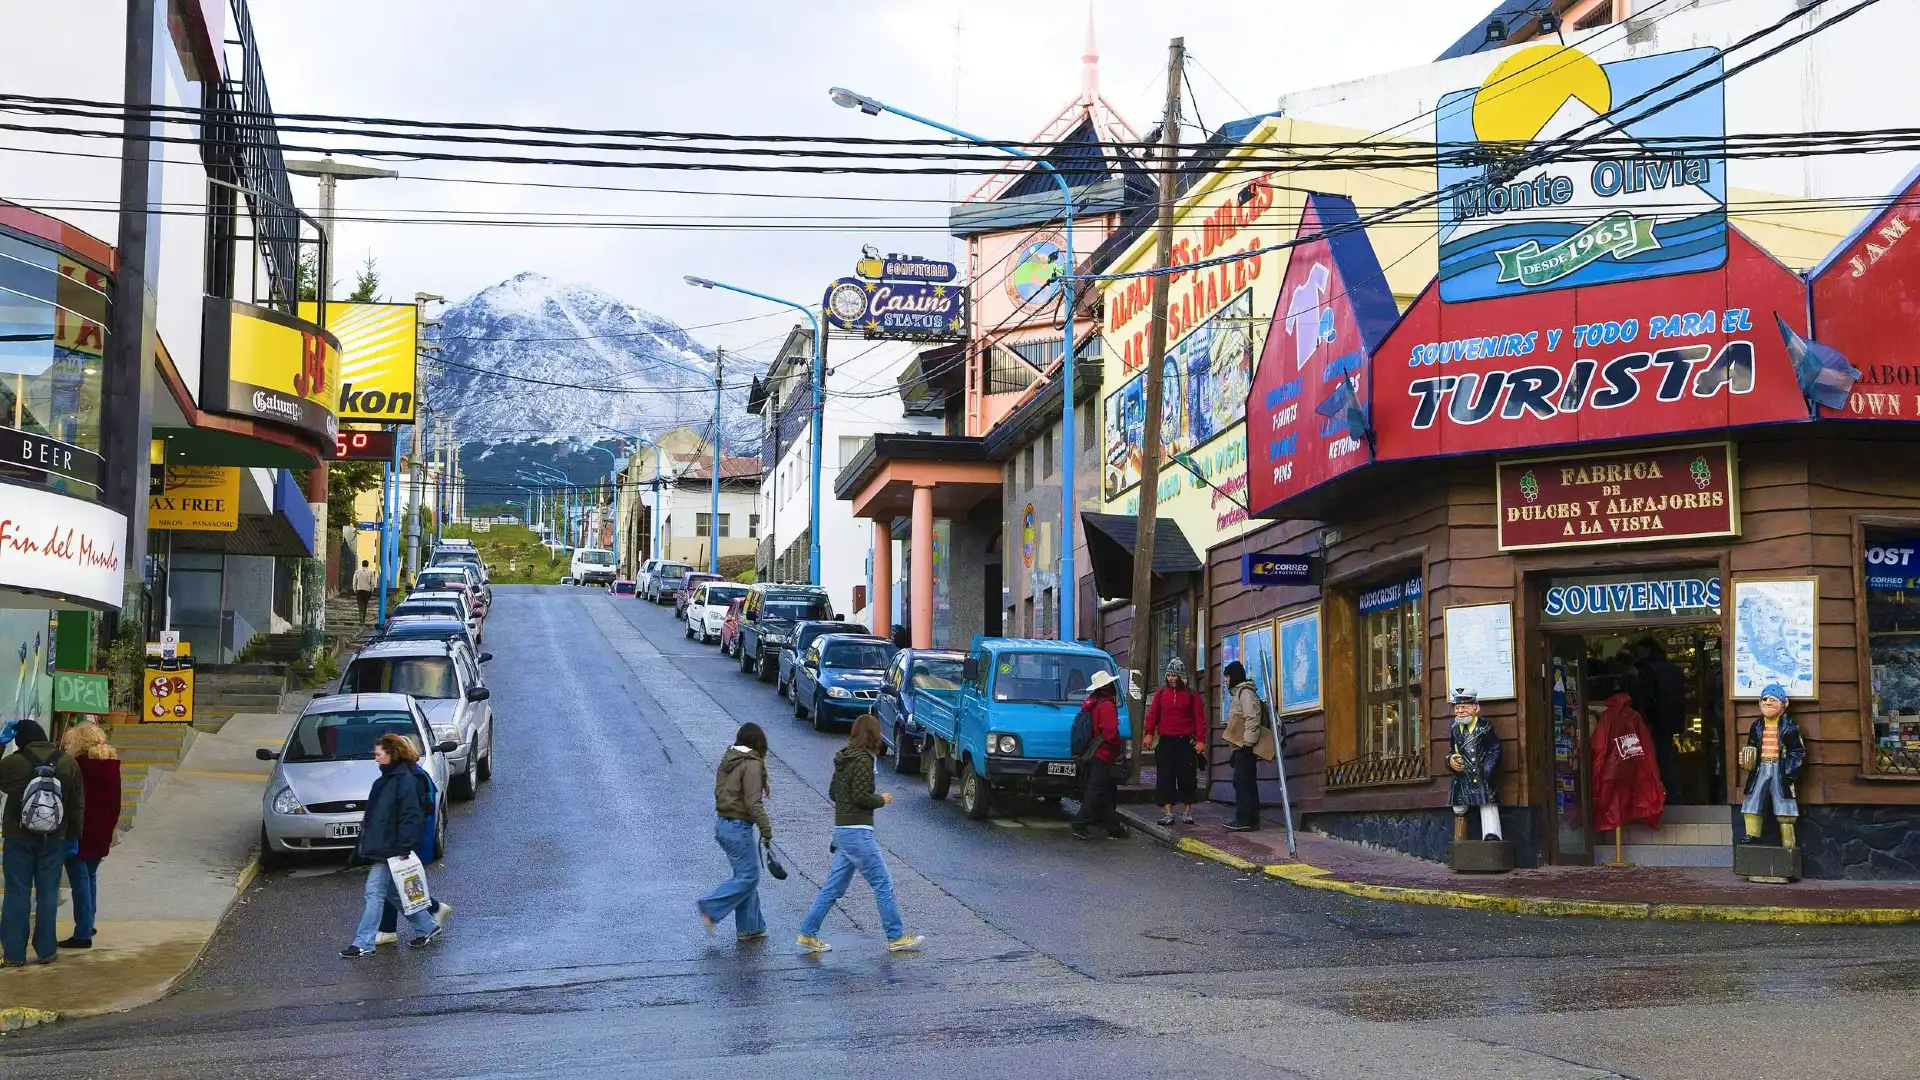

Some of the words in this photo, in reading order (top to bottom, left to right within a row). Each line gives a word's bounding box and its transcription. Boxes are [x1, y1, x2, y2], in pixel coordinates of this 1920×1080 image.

[1452, 170, 1574, 220] Monte
[1591, 151, 1710, 198] Olivia
[1522, 254, 1568, 276] DESDE
[1568, 221, 1630, 261] 1965
[1848, 215, 1912, 278] JAM
[886, 262, 949, 277] CONFITERIA
[869, 287, 951, 316] Casino
[884, 313, 943, 328] STATUS
[1408, 330, 1540, 367] SOUVENIRS
[1546, 328, 1562, 351] Y
[1573, 318, 1639, 348] TODO
[1648, 311, 1716, 339] PARA
[1721, 308, 1753, 333] EL
[1408, 340, 1756, 430] TURISTA
[1272, 402, 1298, 431] T-SHIRTS
[1850, 392, 1901, 416] OWN
[22, 439, 72, 471] BEER
[1273, 461, 1293, 485] PINS
[1560, 460, 1664, 486] FABRICA
[181, 498, 226, 512] FREE
[1602, 485, 1621, 497] DE
[1506, 502, 1581, 522] DULCES
[1586, 501, 1601, 516] Y
[1605, 491, 1724, 515] ALFAJORES
[192, 520, 236, 528] PANASONIC
[1562, 521, 1575, 536] A
[1580, 519, 1604, 535] LA
[1608, 514, 1664, 533] VISTA
[0, 520, 39, 557] Fin
[42, 525, 74, 560] del
[78, 533, 118, 572] Mundo
[1865, 547, 1914, 566] OST
[1871, 576, 1903, 584] CORREO
[1545, 577, 1720, 616] SOUVENIRS
[58, 676, 108, 708] OPEN
